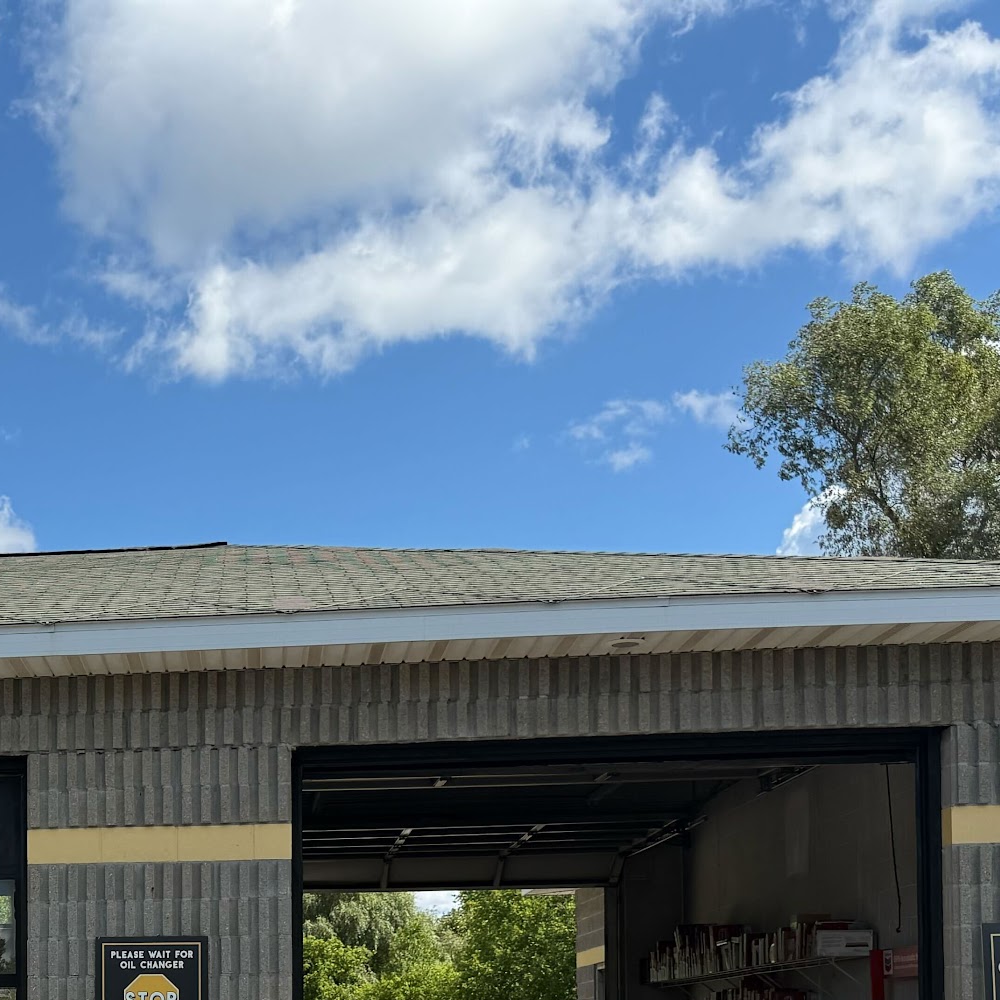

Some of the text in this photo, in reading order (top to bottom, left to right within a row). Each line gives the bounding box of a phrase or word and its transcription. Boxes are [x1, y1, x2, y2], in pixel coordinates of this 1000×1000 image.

[110, 950, 194, 959] PLEASE WAIT FOR
[120, 960, 184, 969] OIL CHANGER
